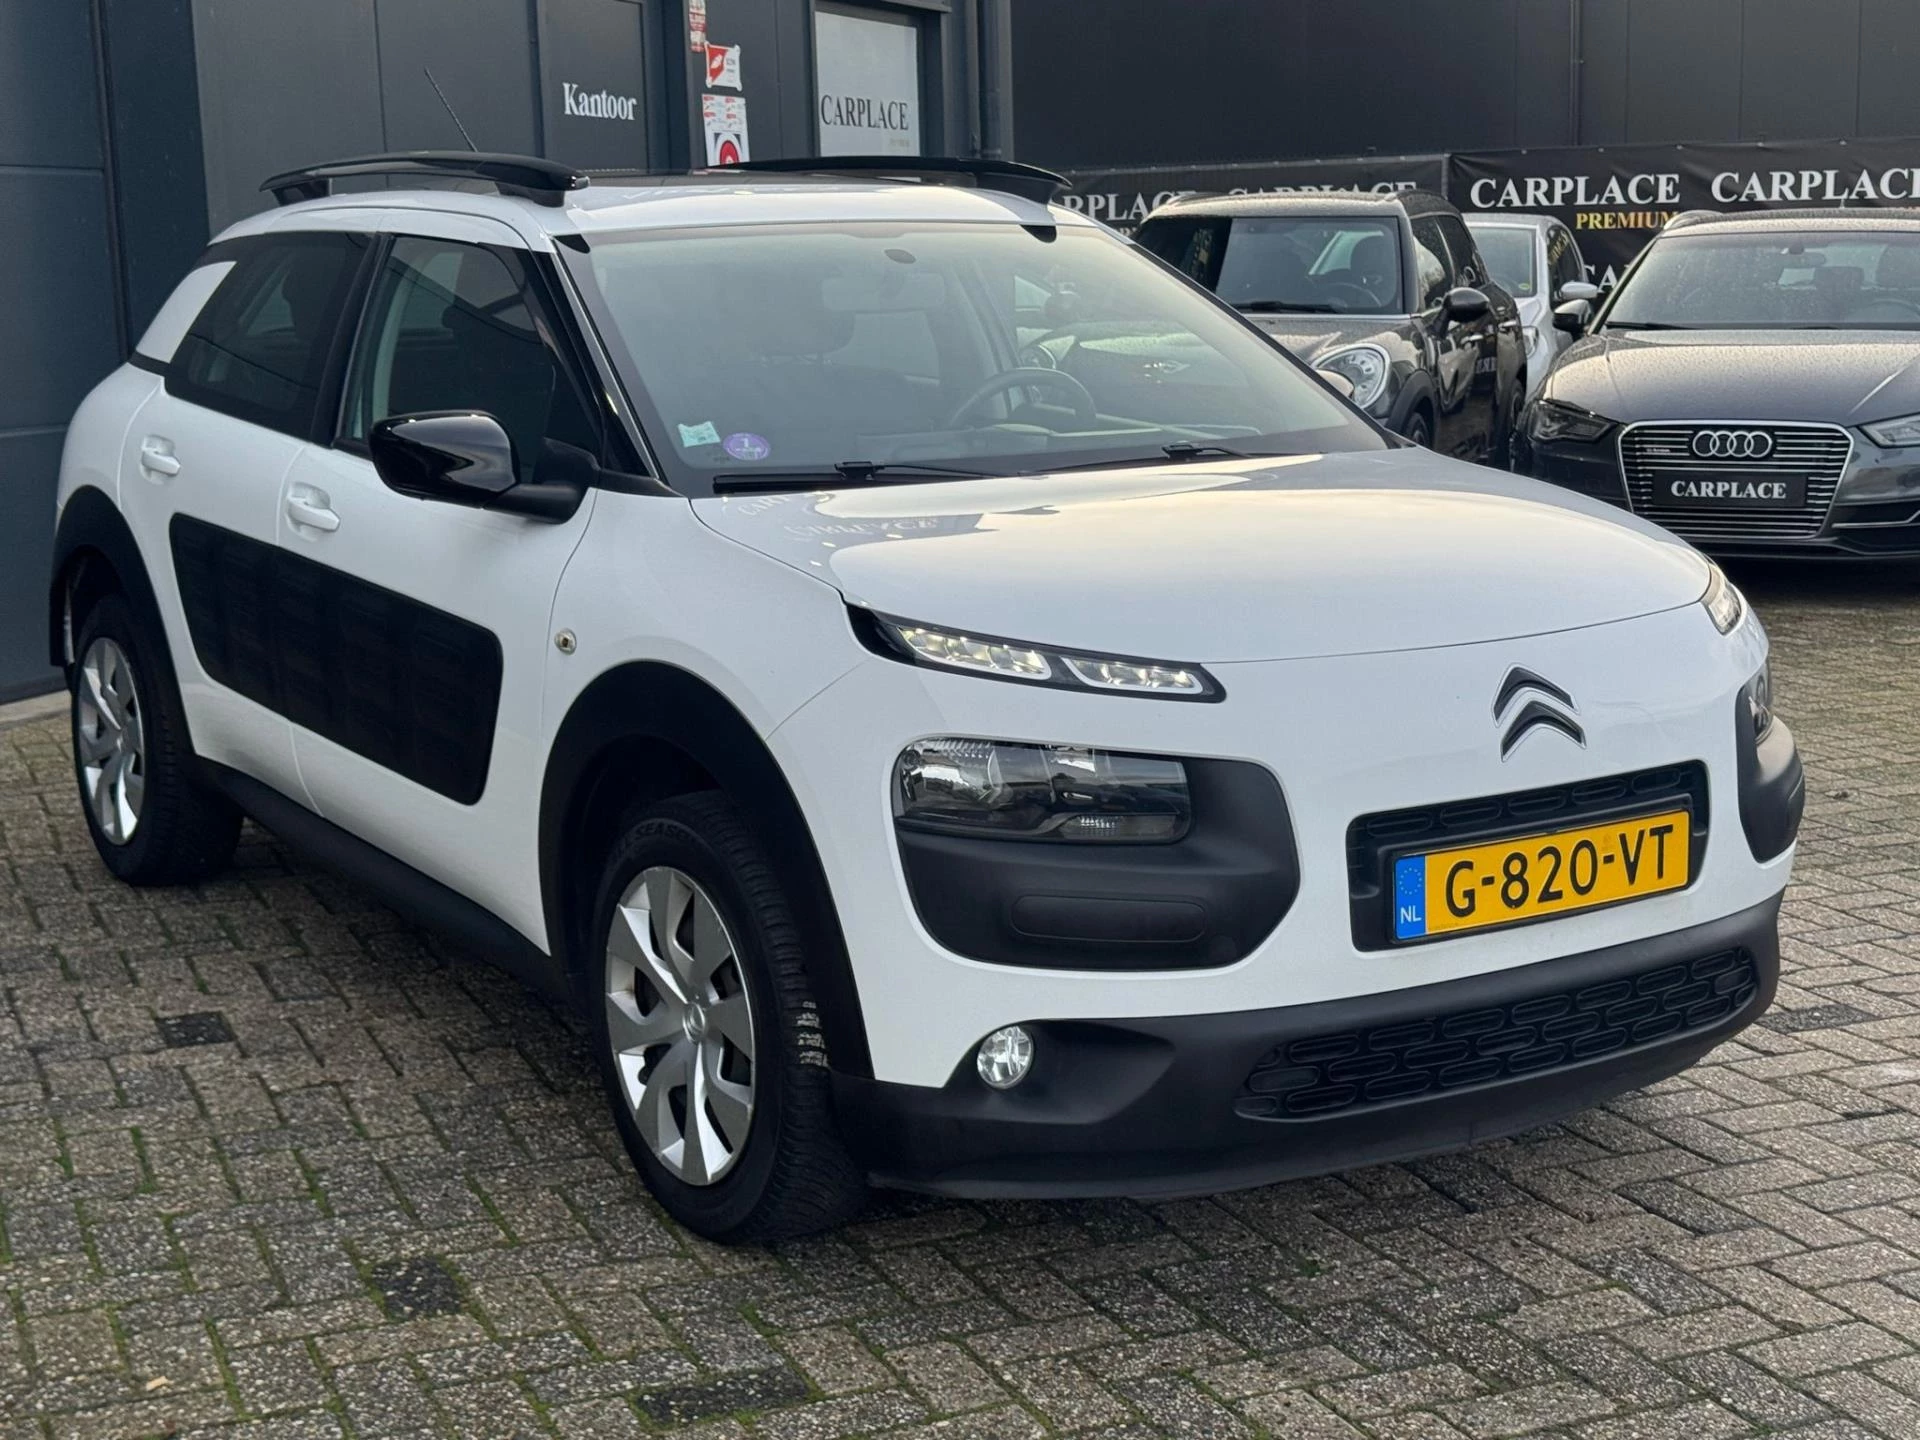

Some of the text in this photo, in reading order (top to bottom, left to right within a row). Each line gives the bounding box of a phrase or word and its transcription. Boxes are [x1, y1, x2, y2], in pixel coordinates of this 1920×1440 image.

[562, 82, 637, 121] Kantoor
[821, 94, 909, 131] CARPLACE
[1469, 173, 1680, 209] CARPLACE
[1671, 481, 1786, 499] CARPLACE
[1445, 824, 1674, 918] G-820-VT
[1400, 905, 1422, 924] NL
